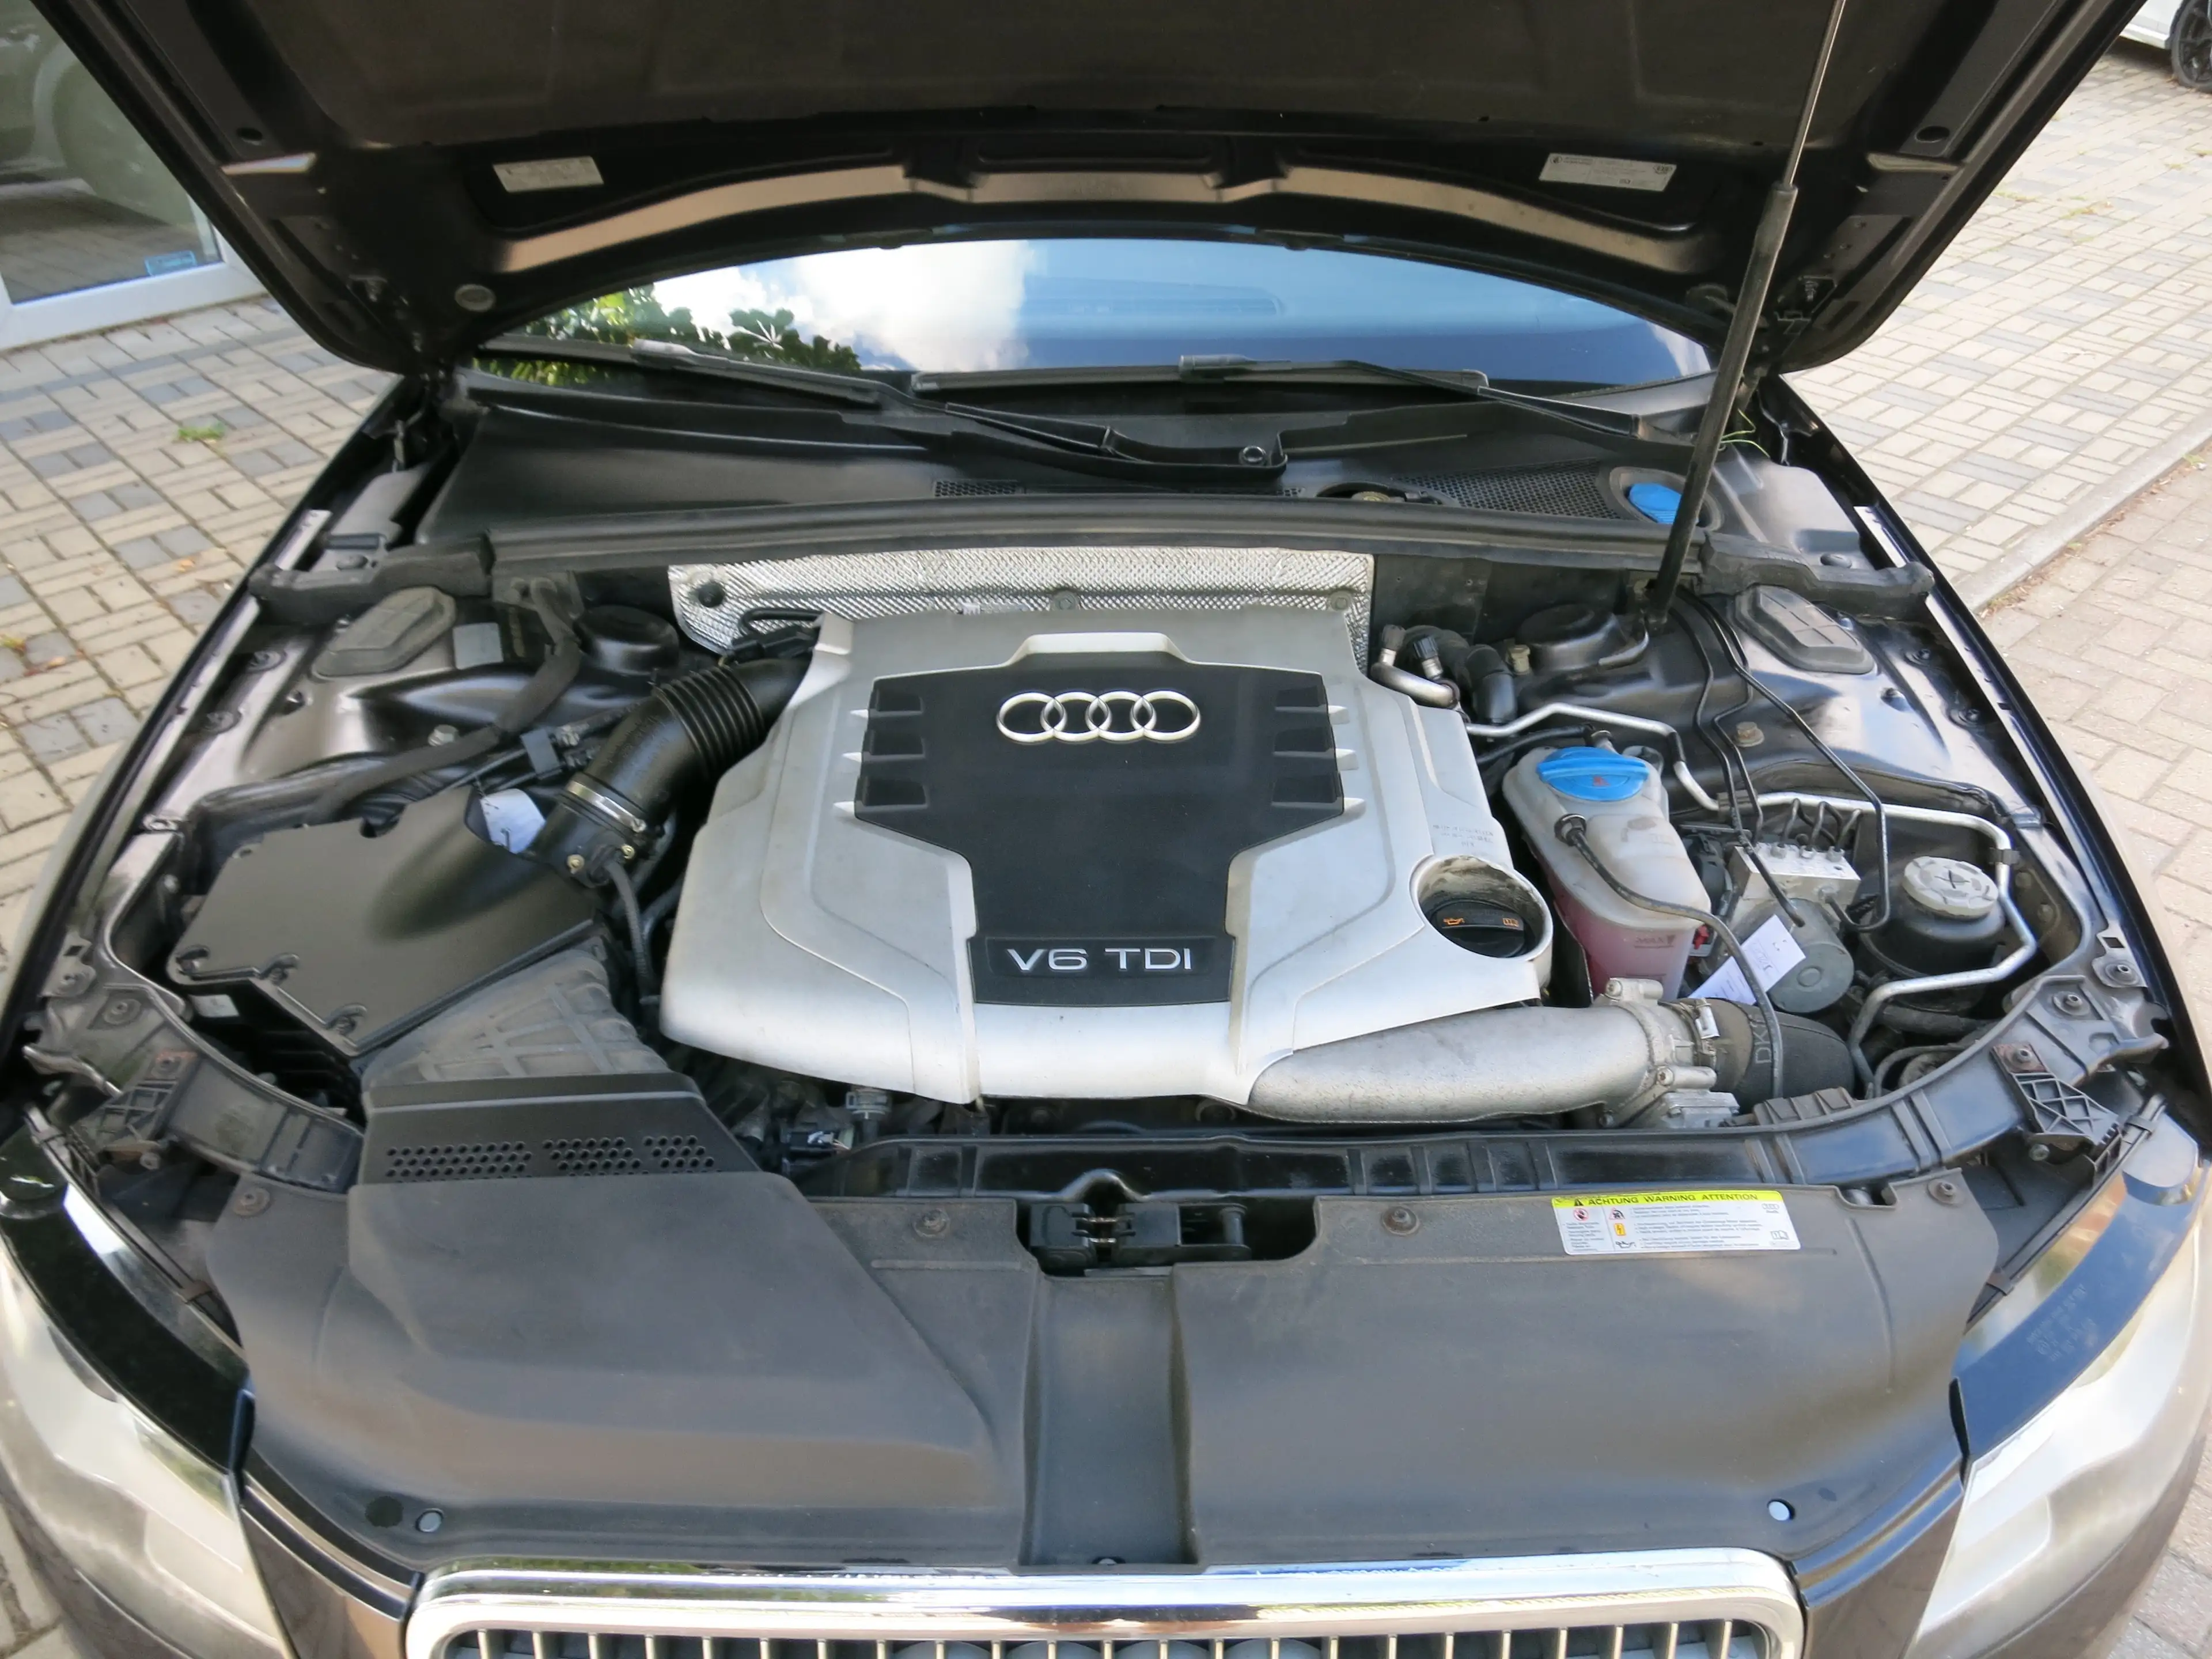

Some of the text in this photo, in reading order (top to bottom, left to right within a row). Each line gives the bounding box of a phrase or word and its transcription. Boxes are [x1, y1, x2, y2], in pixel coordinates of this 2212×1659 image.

[1006, 948, 1192, 971] V6 TDI
[1589, 1194, 1758, 1206] ACHTUNG WARNING ATTENTION
